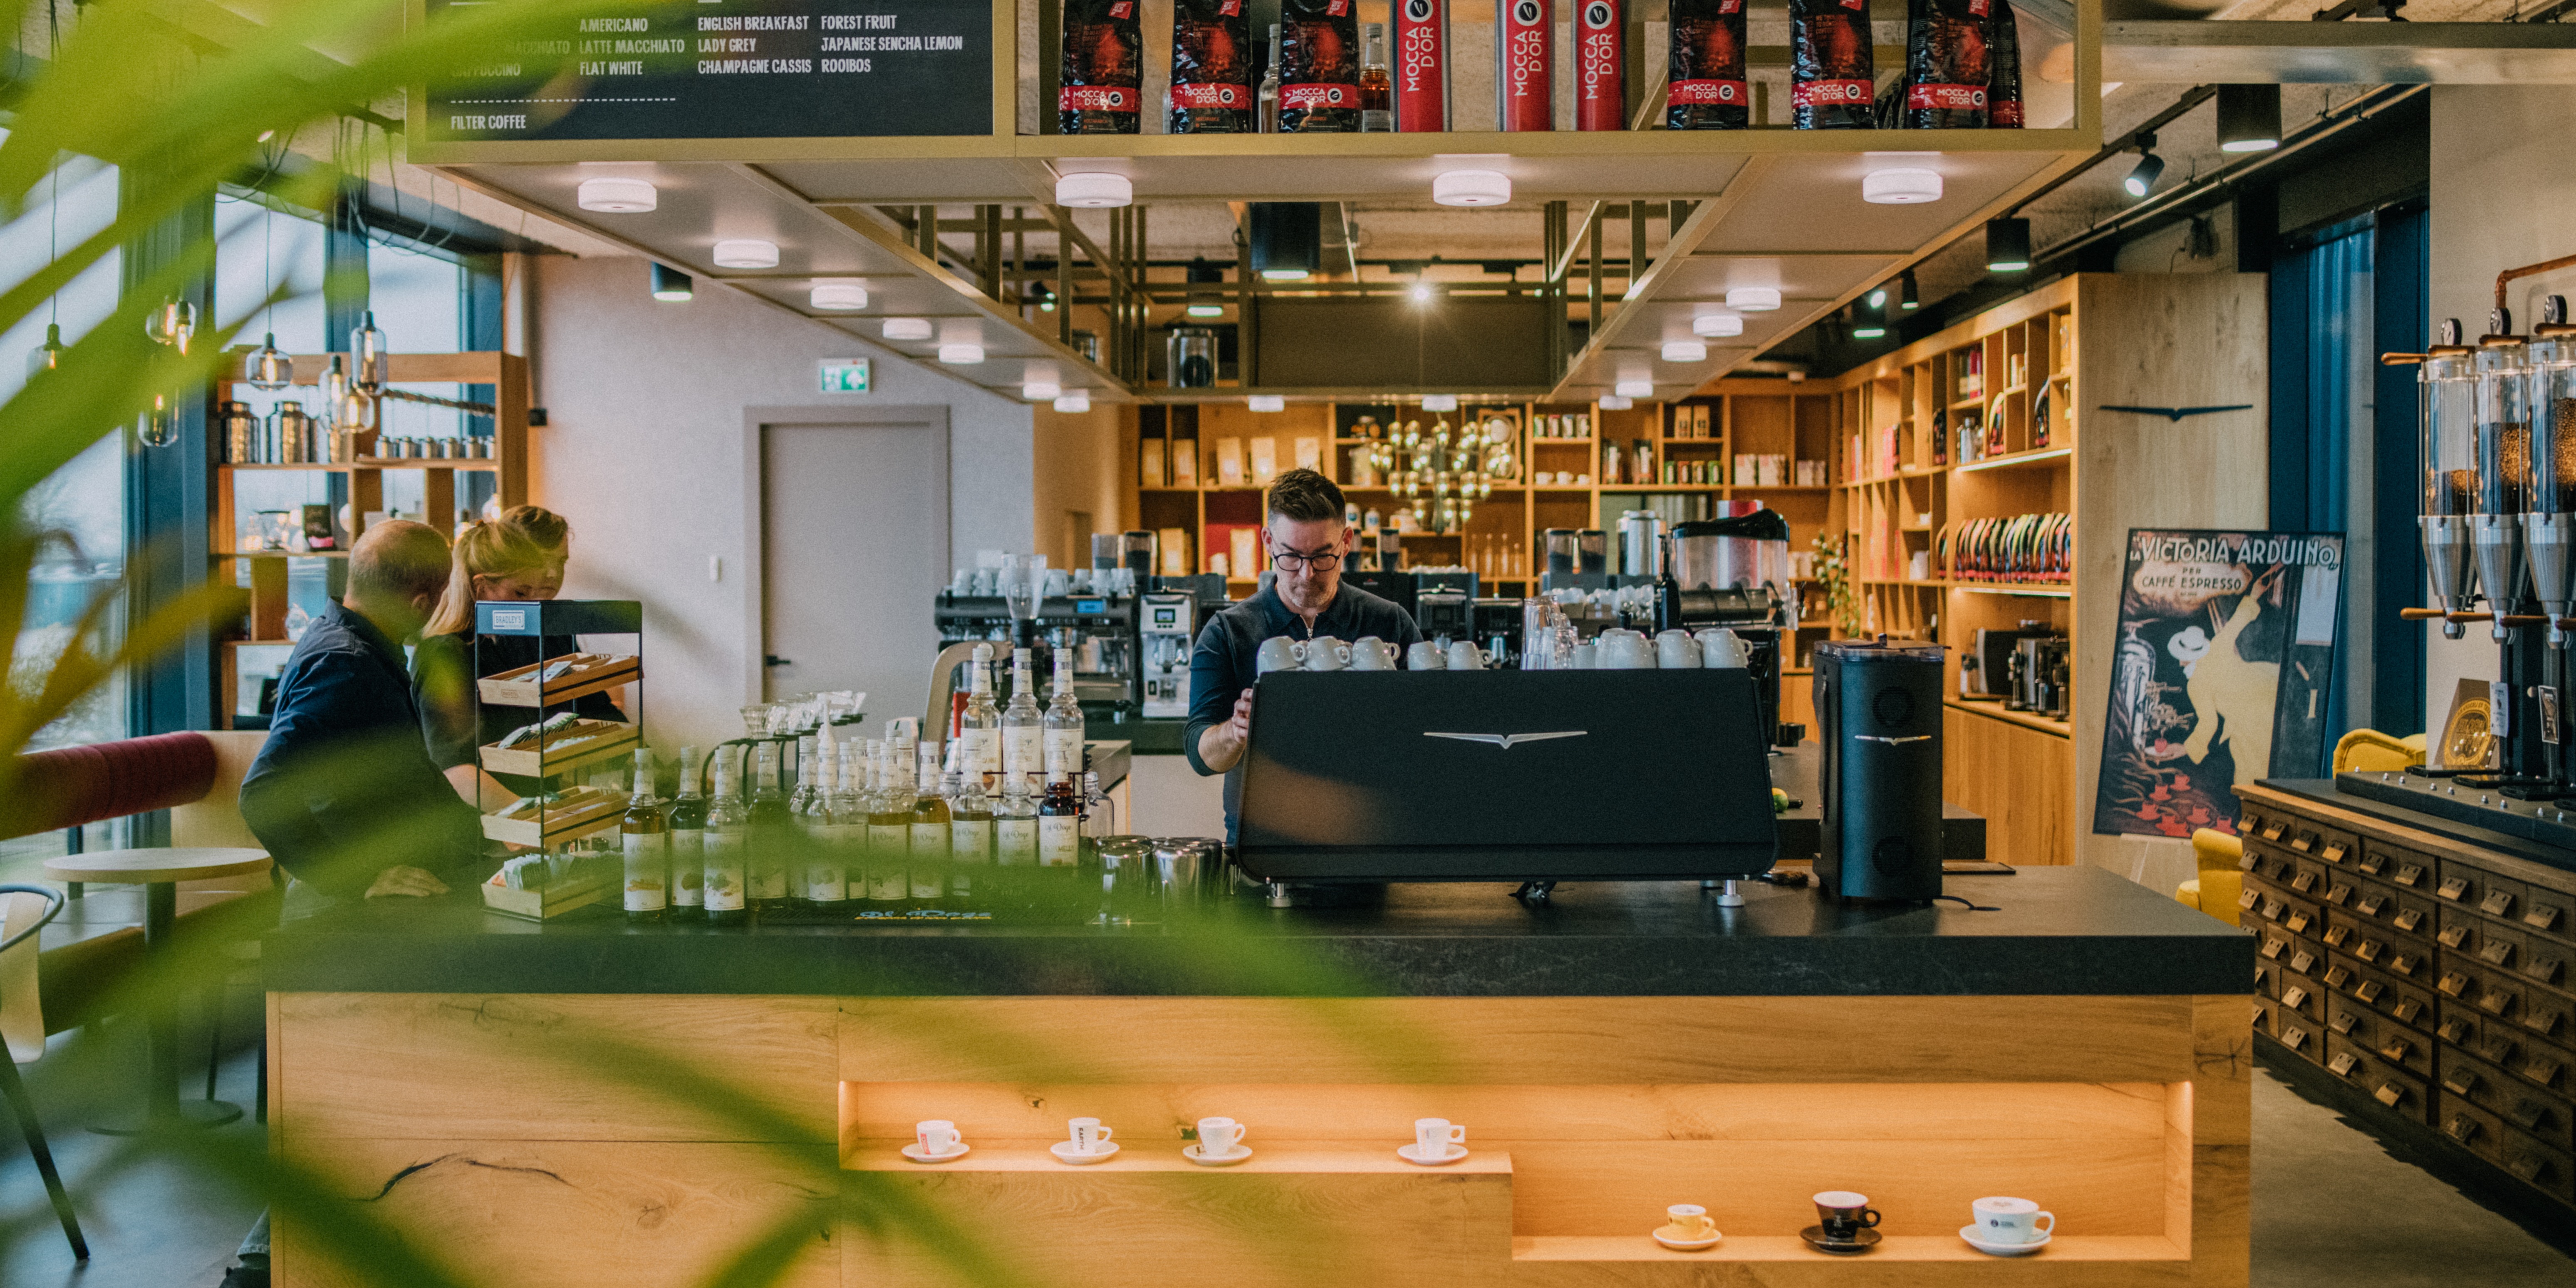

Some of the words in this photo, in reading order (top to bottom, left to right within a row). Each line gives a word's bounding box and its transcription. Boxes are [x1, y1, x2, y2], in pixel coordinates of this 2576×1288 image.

[580, 18, 648, 32] AMERICANO
[698, 17, 741, 30] ENGLISH
[745, 16, 809, 30] BREAKFAST
[822, 15, 862, 30] FOREST
[866, 15, 897, 29] FRUIT
[580, 40, 612, 54] LATTE
[615, 39, 685, 53] MACCHIATO
[698, 38, 726, 52] LADY
[729, 38, 756, 52] GREY
[821, 37, 876, 51] JAPANESE
[879, 37, 921, 50] SENCHA
[925, 36, 962, 50] LEMON
[1420, 26, 1434, 67] D'OR
[1529, 30, 1542, 72] D'OR
[1599, 33, 1612, 74] D'OR
[698, 59, 769, 74] CHAMPAGNE
[772, 59, 811, 73] CASSIS
[821, 59, 871, 72] ROOIBOS
[1406, 27, 1419, 92] MOCCA
[1514, 31, 1528, 96] MOCCA
[1585, 34, 1598, 99] MOCCA
[580, 61, 605, 75] FLAT
[609, 61, 643, 75] WHITE
[1293, 88, 1325, 96] MOCCA
[1683, 84, 1717, 92] MOCCA
[1695, 91, 1717, 99] D'OR
[1810, 84, 1844, 92] MOCCA
[1937, 89, 1970, 97] MOCCA
[451, 116, 485, 129] FILTER
[489, 115, 526, 129] COFFEE
[2130, 550, 2141, 561] LA
[2181, 577, 2241, 590] ESPRESSO
[495, 615, 521, 624] BRADLEY'S
